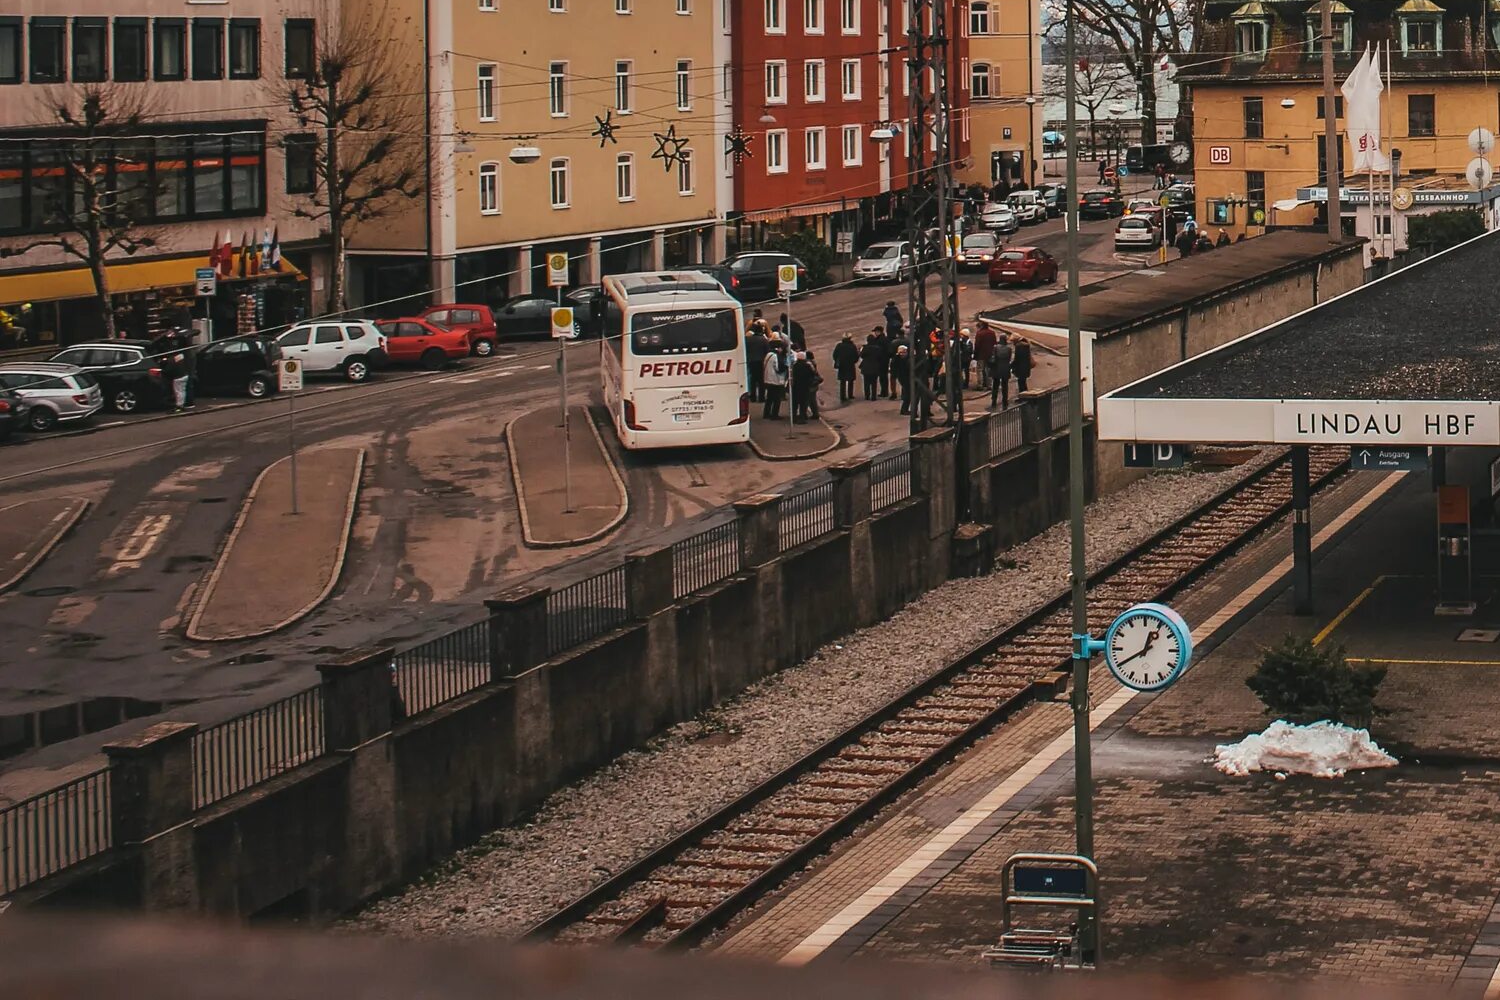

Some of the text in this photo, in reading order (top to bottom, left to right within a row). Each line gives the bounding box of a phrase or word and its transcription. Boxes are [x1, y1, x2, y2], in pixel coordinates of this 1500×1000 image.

[1212, 149, 1229, 161] DB
[639, 359, 732, 378] PETROLLI
[1297, 413, 1476, 436] LINDAU HBF
[1379, 451, 1410, 460] Ausgang
